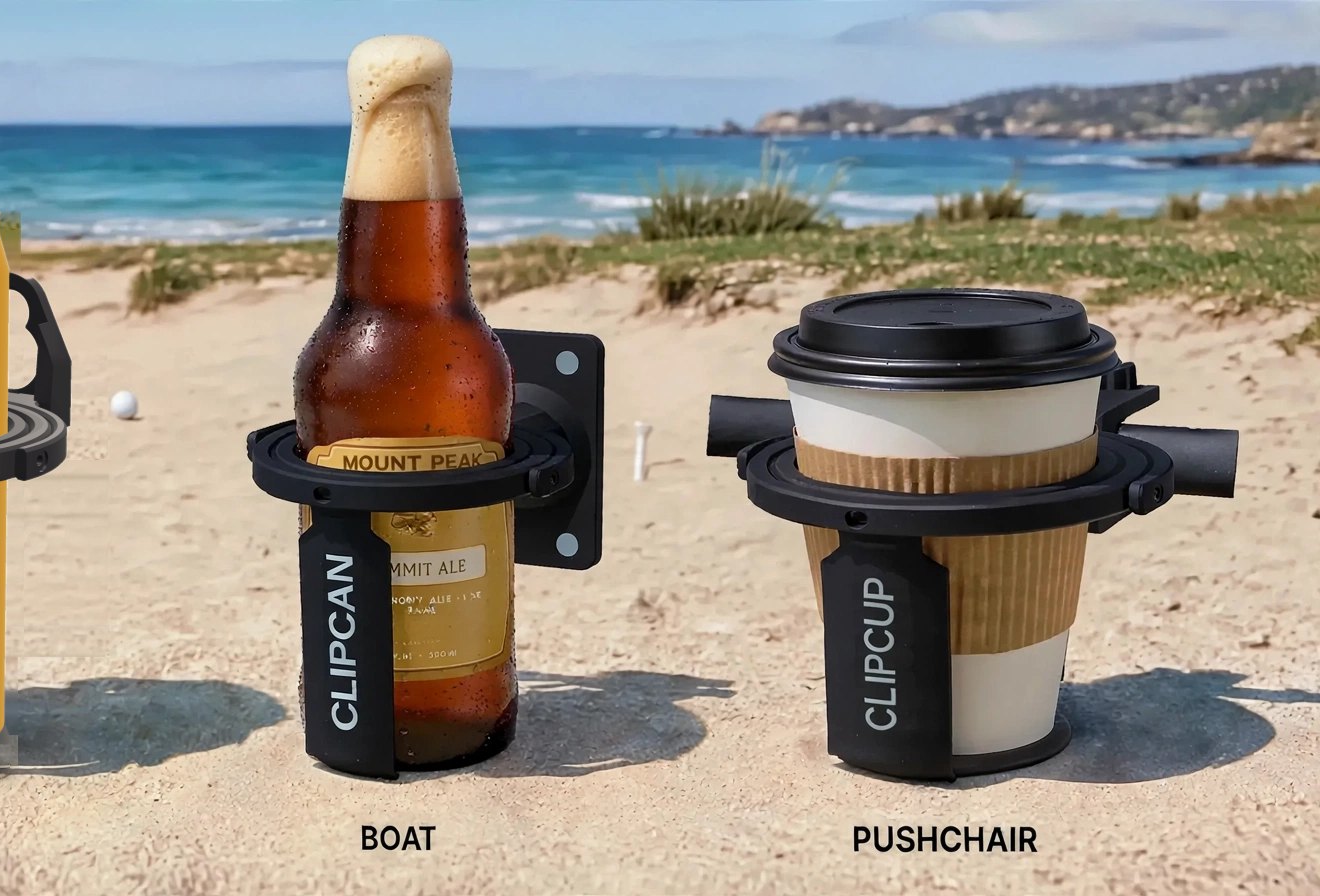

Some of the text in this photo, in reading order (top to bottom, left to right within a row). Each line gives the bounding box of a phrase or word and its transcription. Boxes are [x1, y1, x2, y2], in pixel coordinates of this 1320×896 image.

[342, 452, 483, 471] MOUNT PEAK
[390, 559, 466, 577] MMIT ALE
[325, 553, 359, 731] CLIPCAN
[863, 577, 898, 731] CLIPCUP
